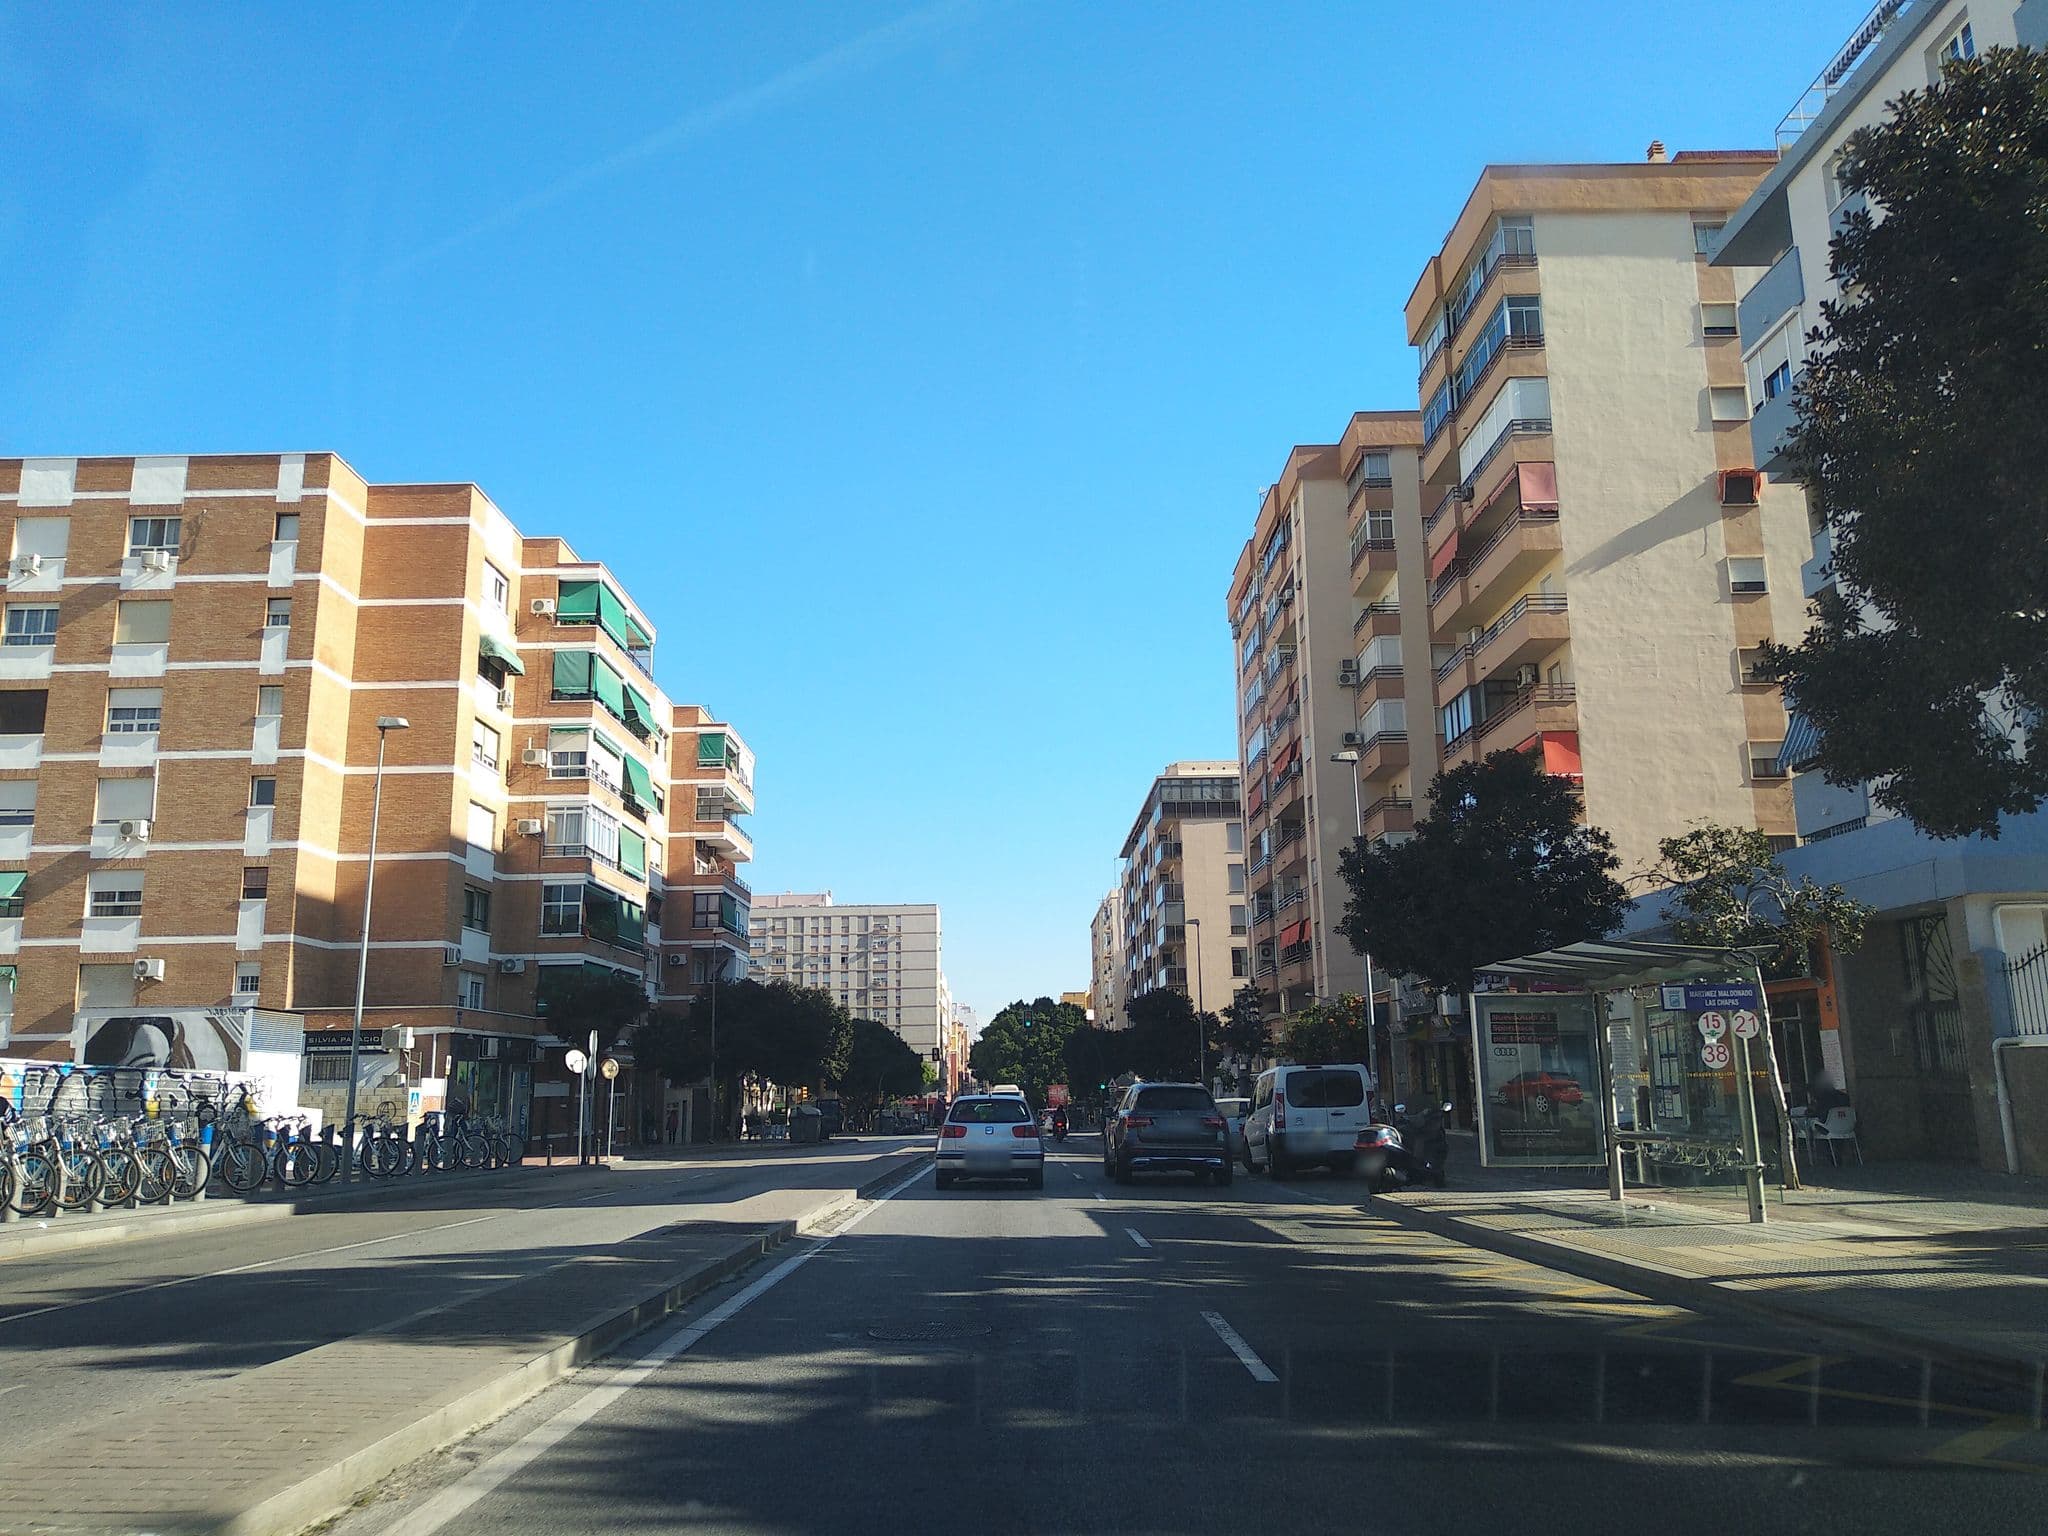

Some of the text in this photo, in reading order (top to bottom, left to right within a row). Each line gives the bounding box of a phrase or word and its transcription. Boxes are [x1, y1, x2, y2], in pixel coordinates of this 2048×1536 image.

[1703, 1015, 1721, 1029] 15
[1735, 1015, 1756, 1033] 21
[1703, 1045, 1728, 1063] 38
